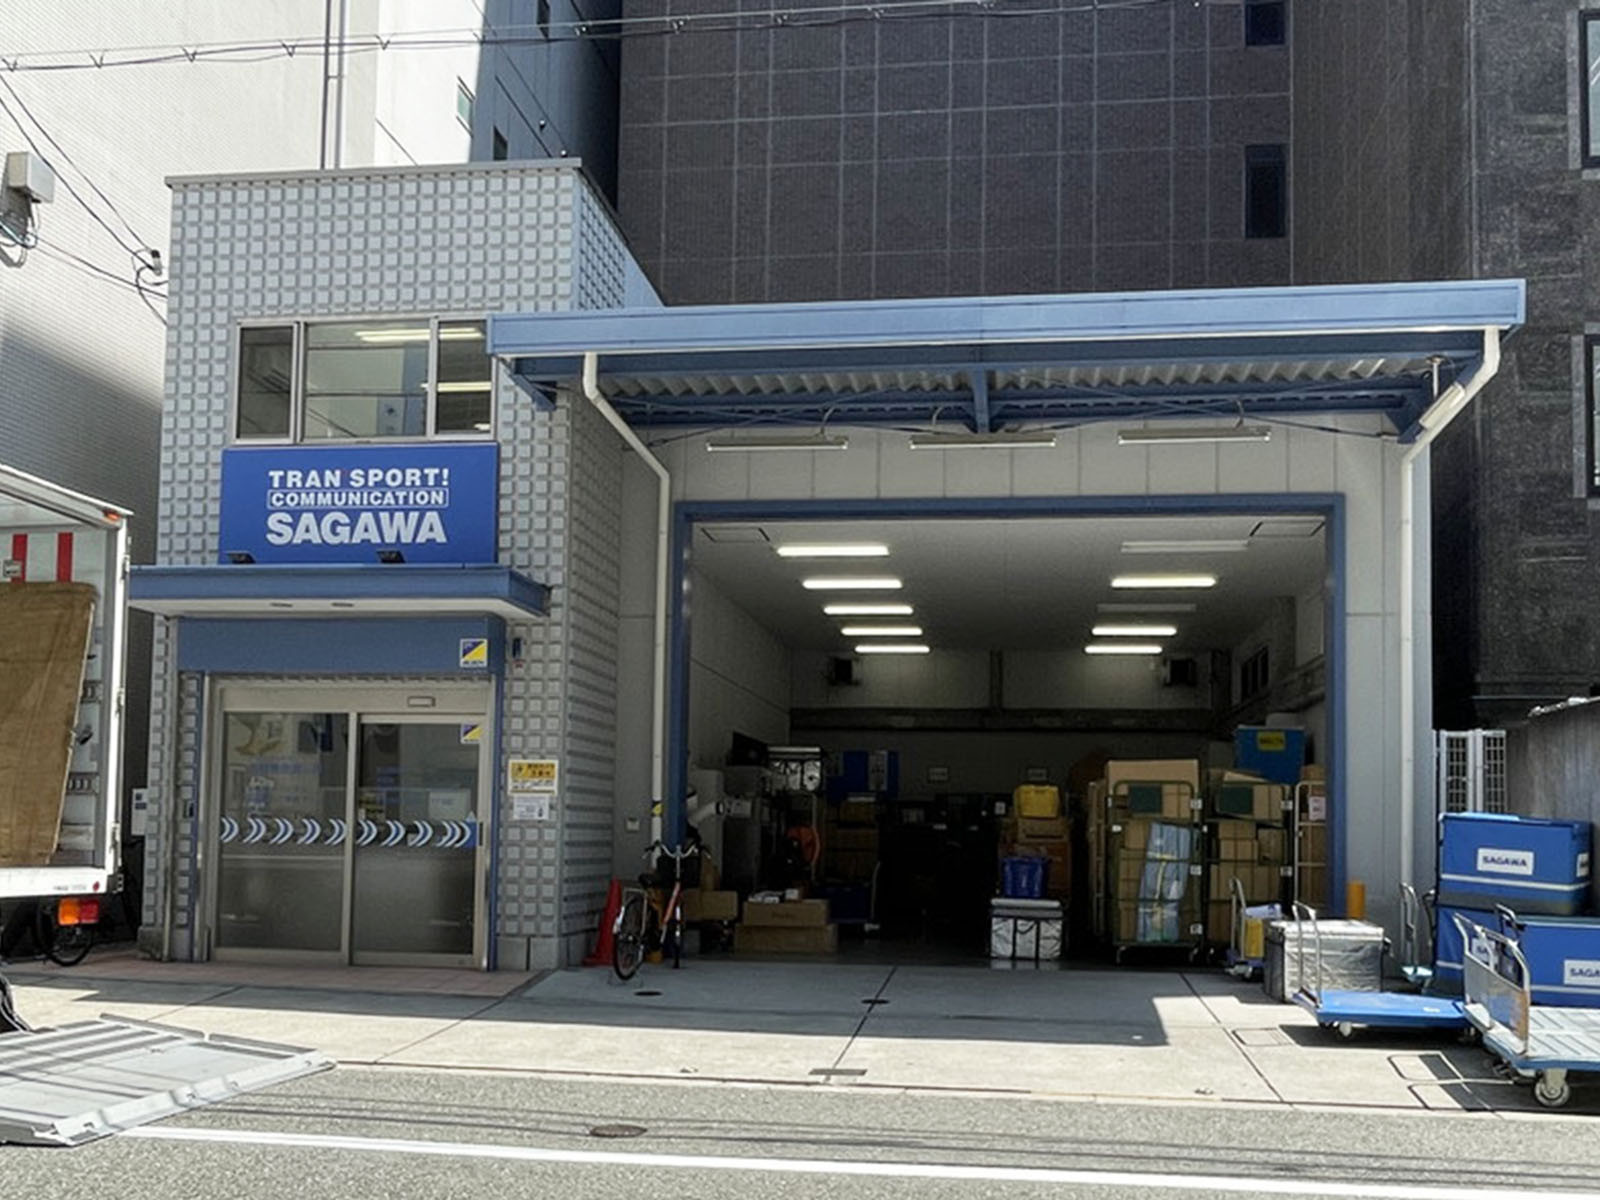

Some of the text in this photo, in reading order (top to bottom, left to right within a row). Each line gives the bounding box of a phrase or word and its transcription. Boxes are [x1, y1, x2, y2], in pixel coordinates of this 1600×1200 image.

[271, 490, 444, 507] COMMUNICATION
[266, 510, 447, 545] SAGAWA
[1482, 855, 1527, 867] SAGAWA
